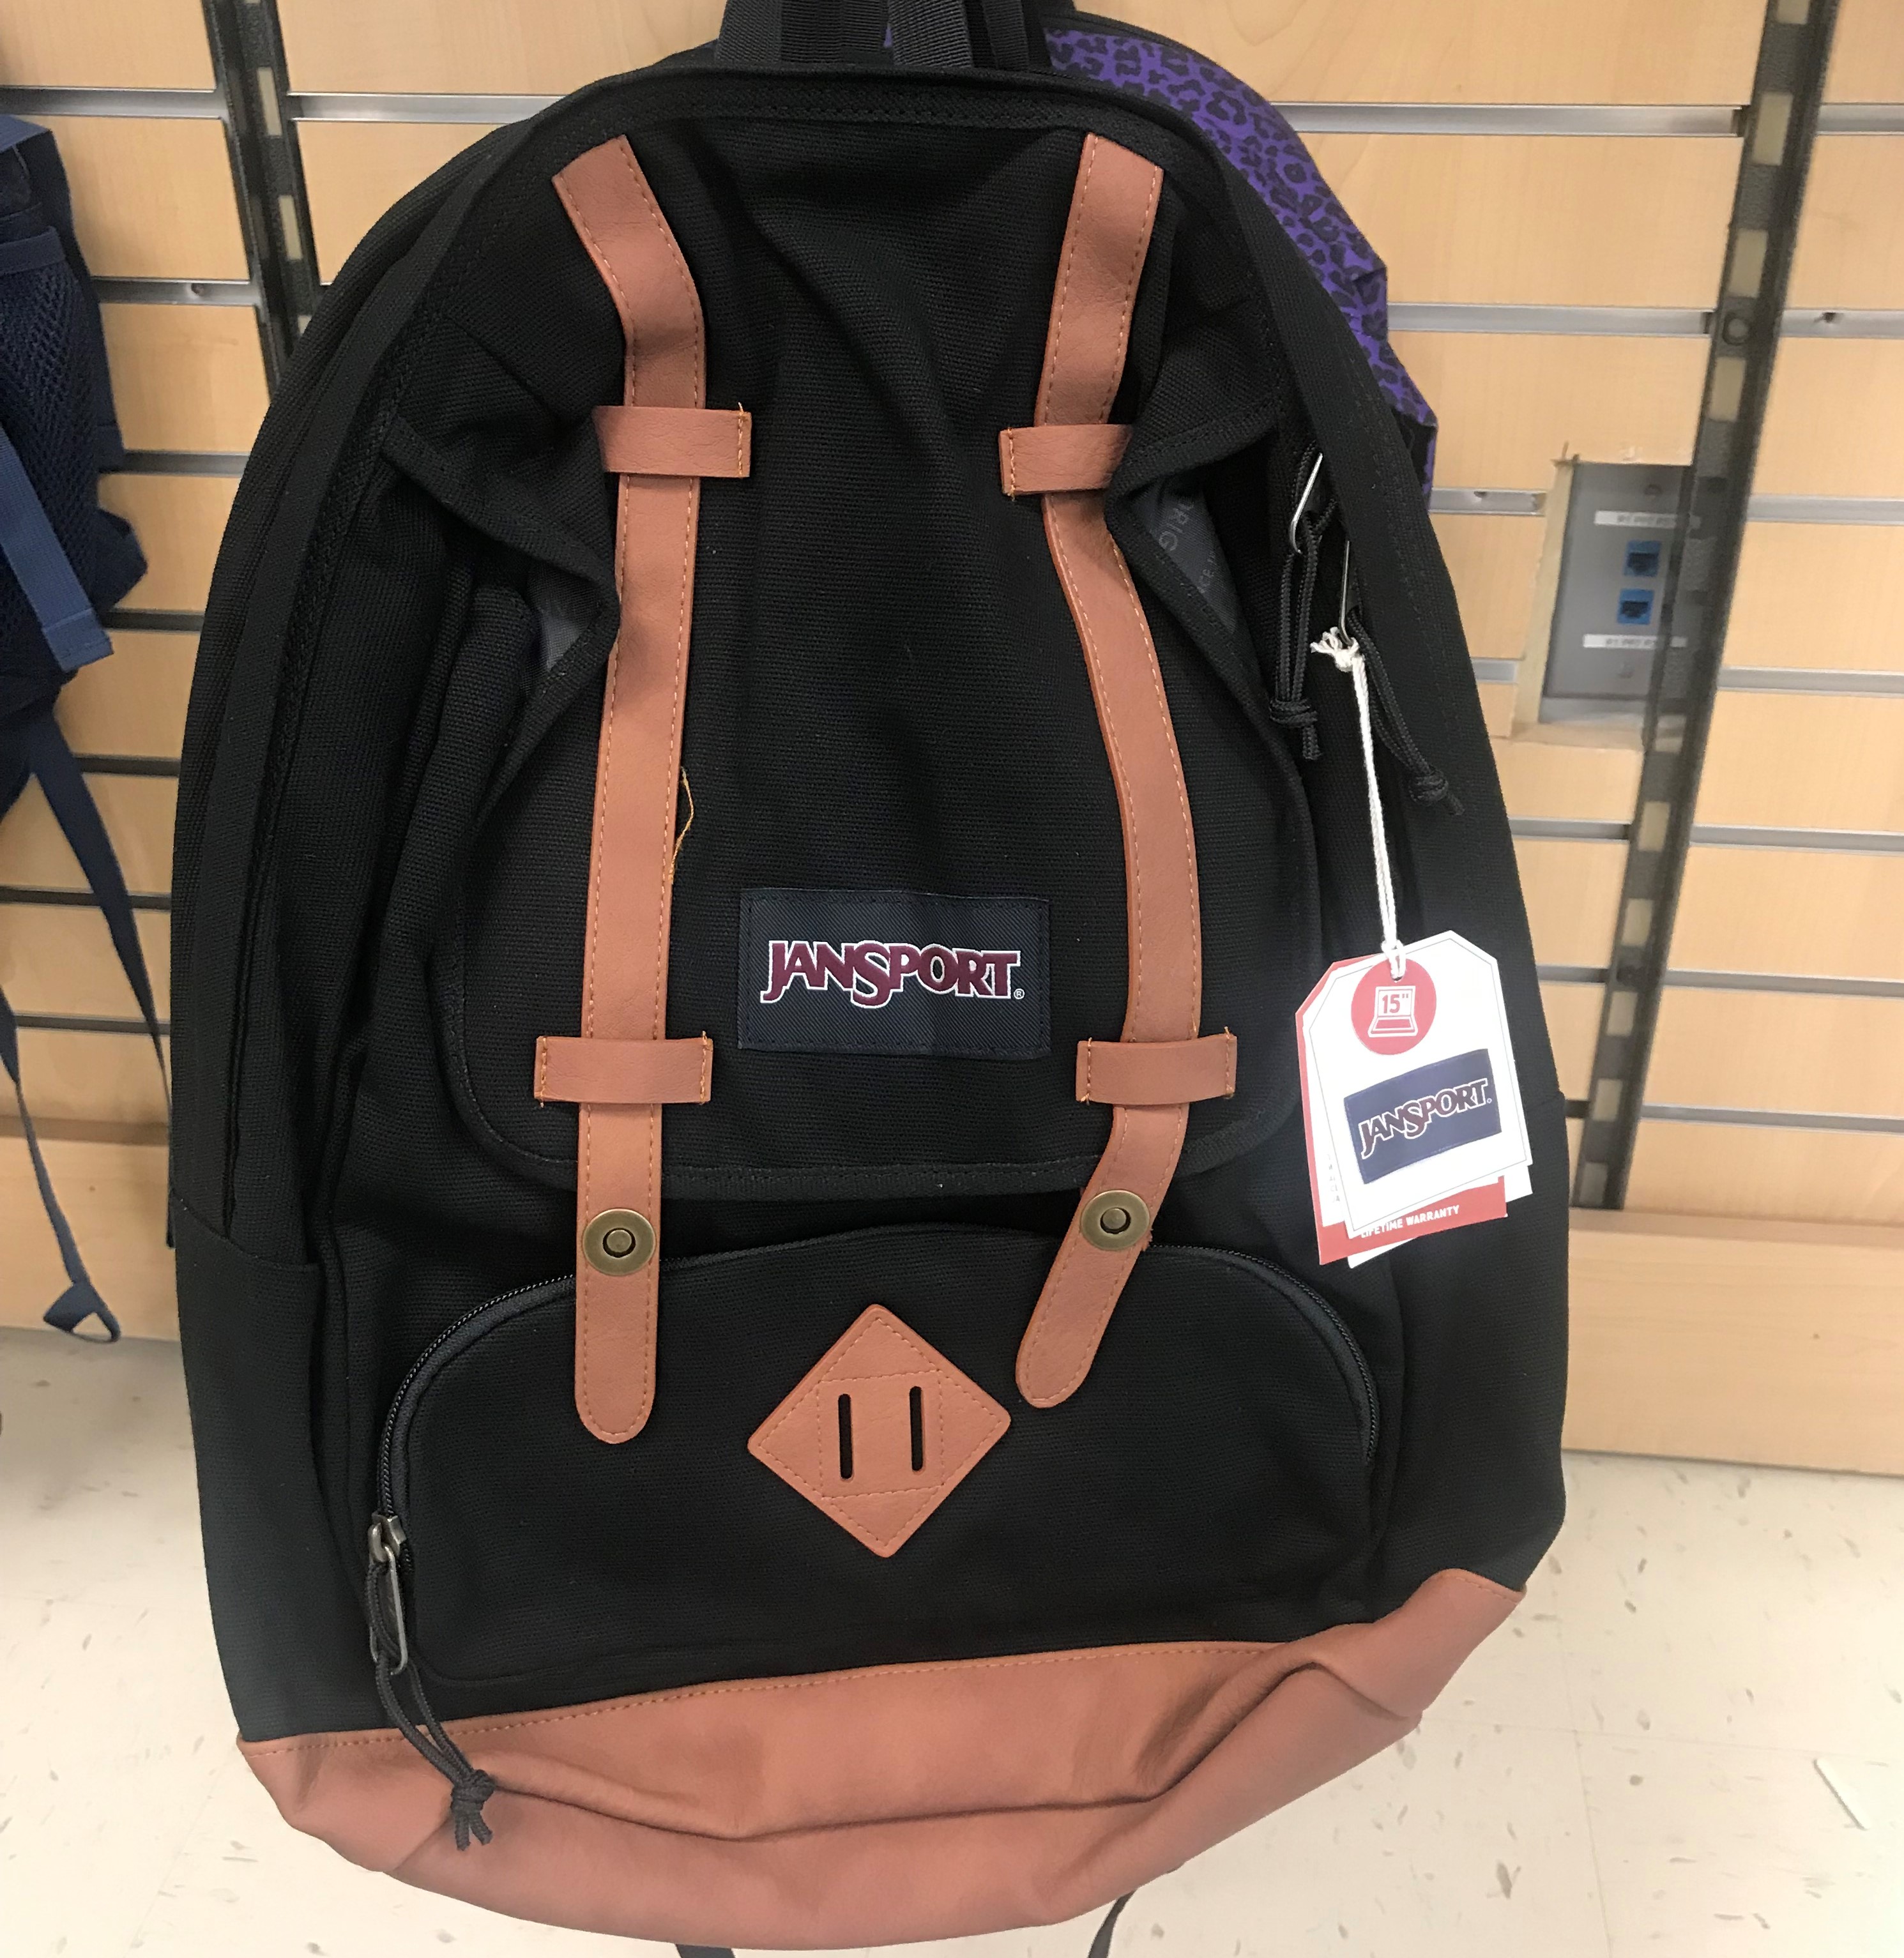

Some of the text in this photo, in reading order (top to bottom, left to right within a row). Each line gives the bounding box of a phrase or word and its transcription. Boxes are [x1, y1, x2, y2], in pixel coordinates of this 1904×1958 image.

[761, 940, 1021, 1008] JANSPORT
[1359, 1078, 1488, 1159] JANSPORT
[1406, 1204, 1460, 1226] WARRANTY
